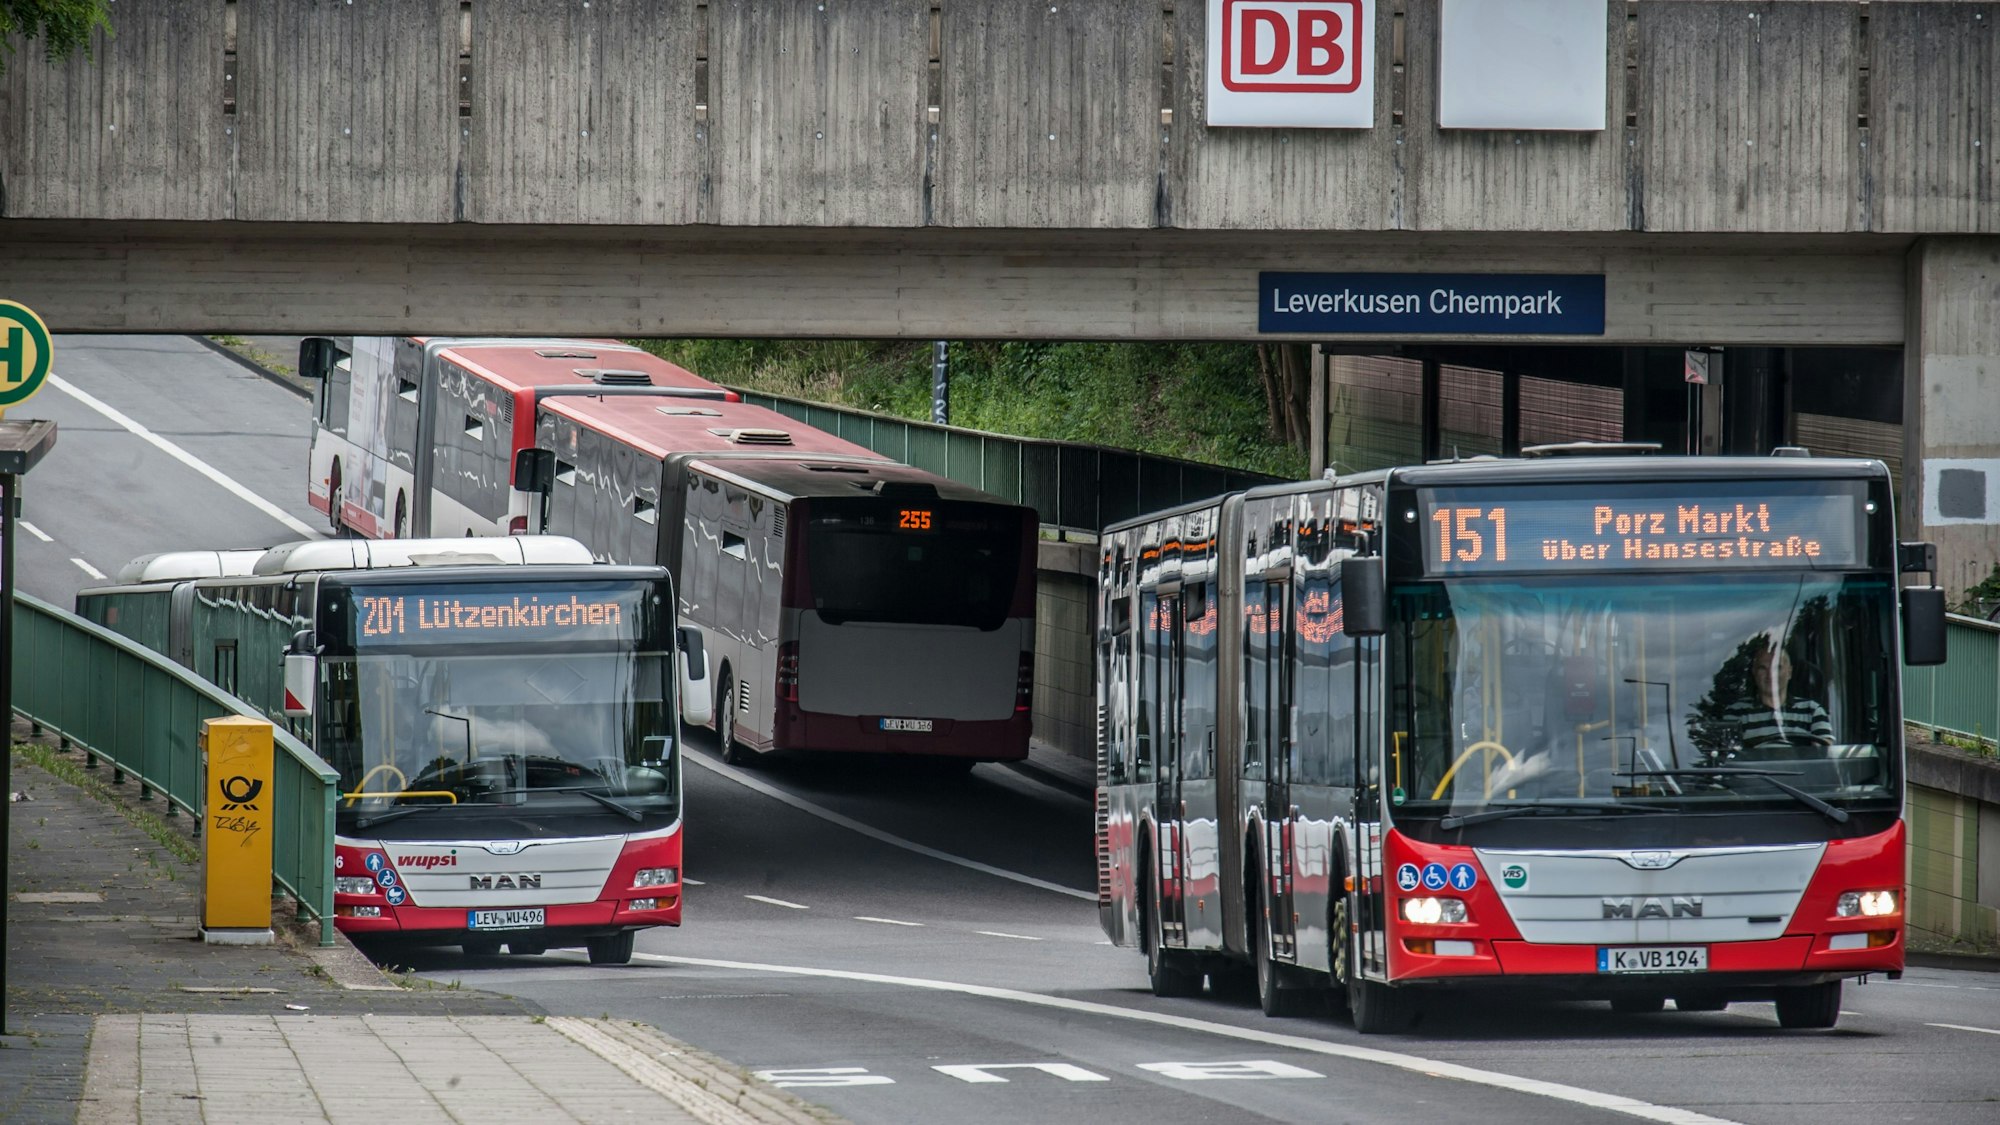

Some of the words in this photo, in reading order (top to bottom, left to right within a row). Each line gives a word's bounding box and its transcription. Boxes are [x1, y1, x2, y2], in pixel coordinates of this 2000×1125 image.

[1240, 9, 1345, 76] DB
[1273, 288, 1421, 314] Leverkusen
[1429, 289, 1562, 320] Chempark
[900, 510, 931, 529] 255
[1432, 507, 1506, 562] 151
[1594, 505, 1665, 535] Porz
[1678, 503, 1770, 533] Markt
[1542, 540, 1611, 561] über
[1624, 536, 1821, 560] Hansestraße
[363, 596, 405, 635] 201
[419, 595, 621, 630] Lützenkirchen
[397, 849, 457, 870] wupsi
[470, 874, 541, 889] MAN
[1502, 869, 1521, 878] VRS
[476, 912, 497, 925] LEV
[1602, 896, 1703, 919] MAN
[1615, 951, 1626, 969] K
[1639, 950, 1662, 968] VB
[1666, 950, 1698, 967] 194
